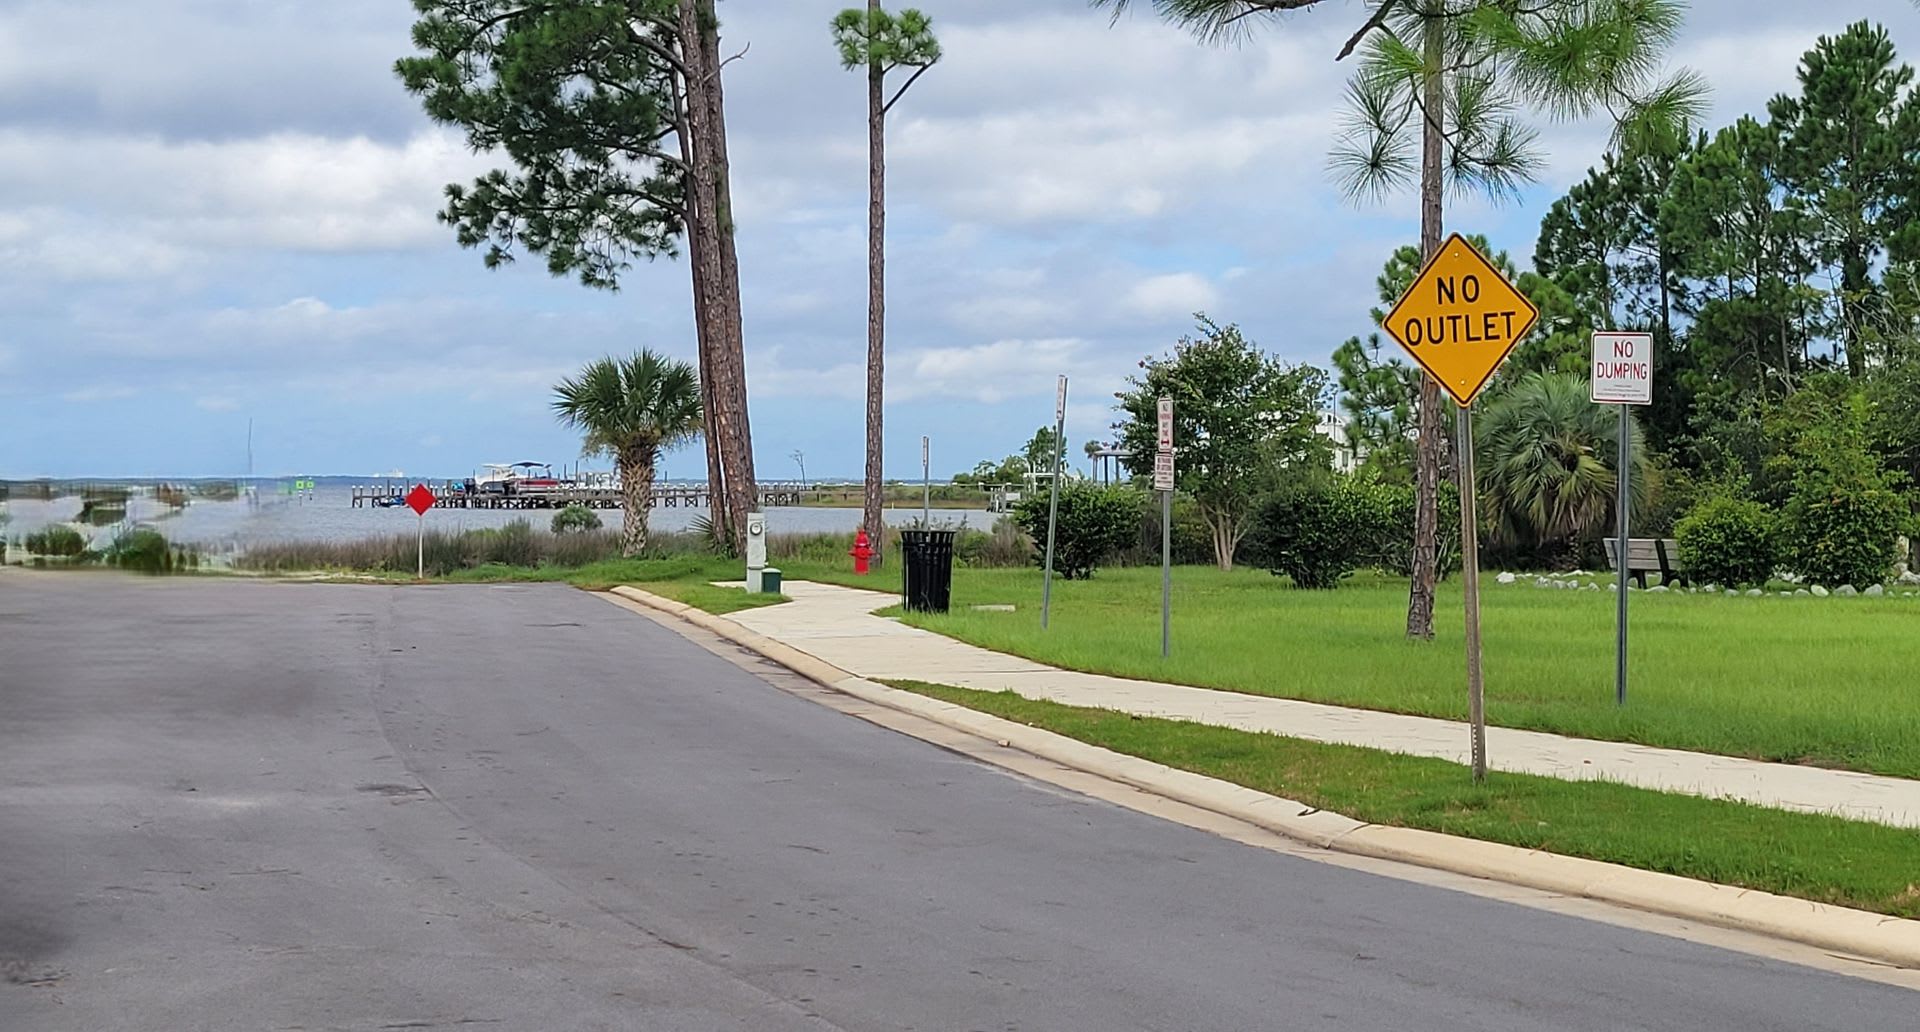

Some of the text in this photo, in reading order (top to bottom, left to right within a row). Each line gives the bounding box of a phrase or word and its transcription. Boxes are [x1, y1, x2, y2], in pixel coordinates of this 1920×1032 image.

[1437, 275, 1480, 305] NO
[1405, 311, 1516, 346] OUTLET
[1614, 341, 1633, 358] NO
[1597, 362, 1647, 380] DUMPING
